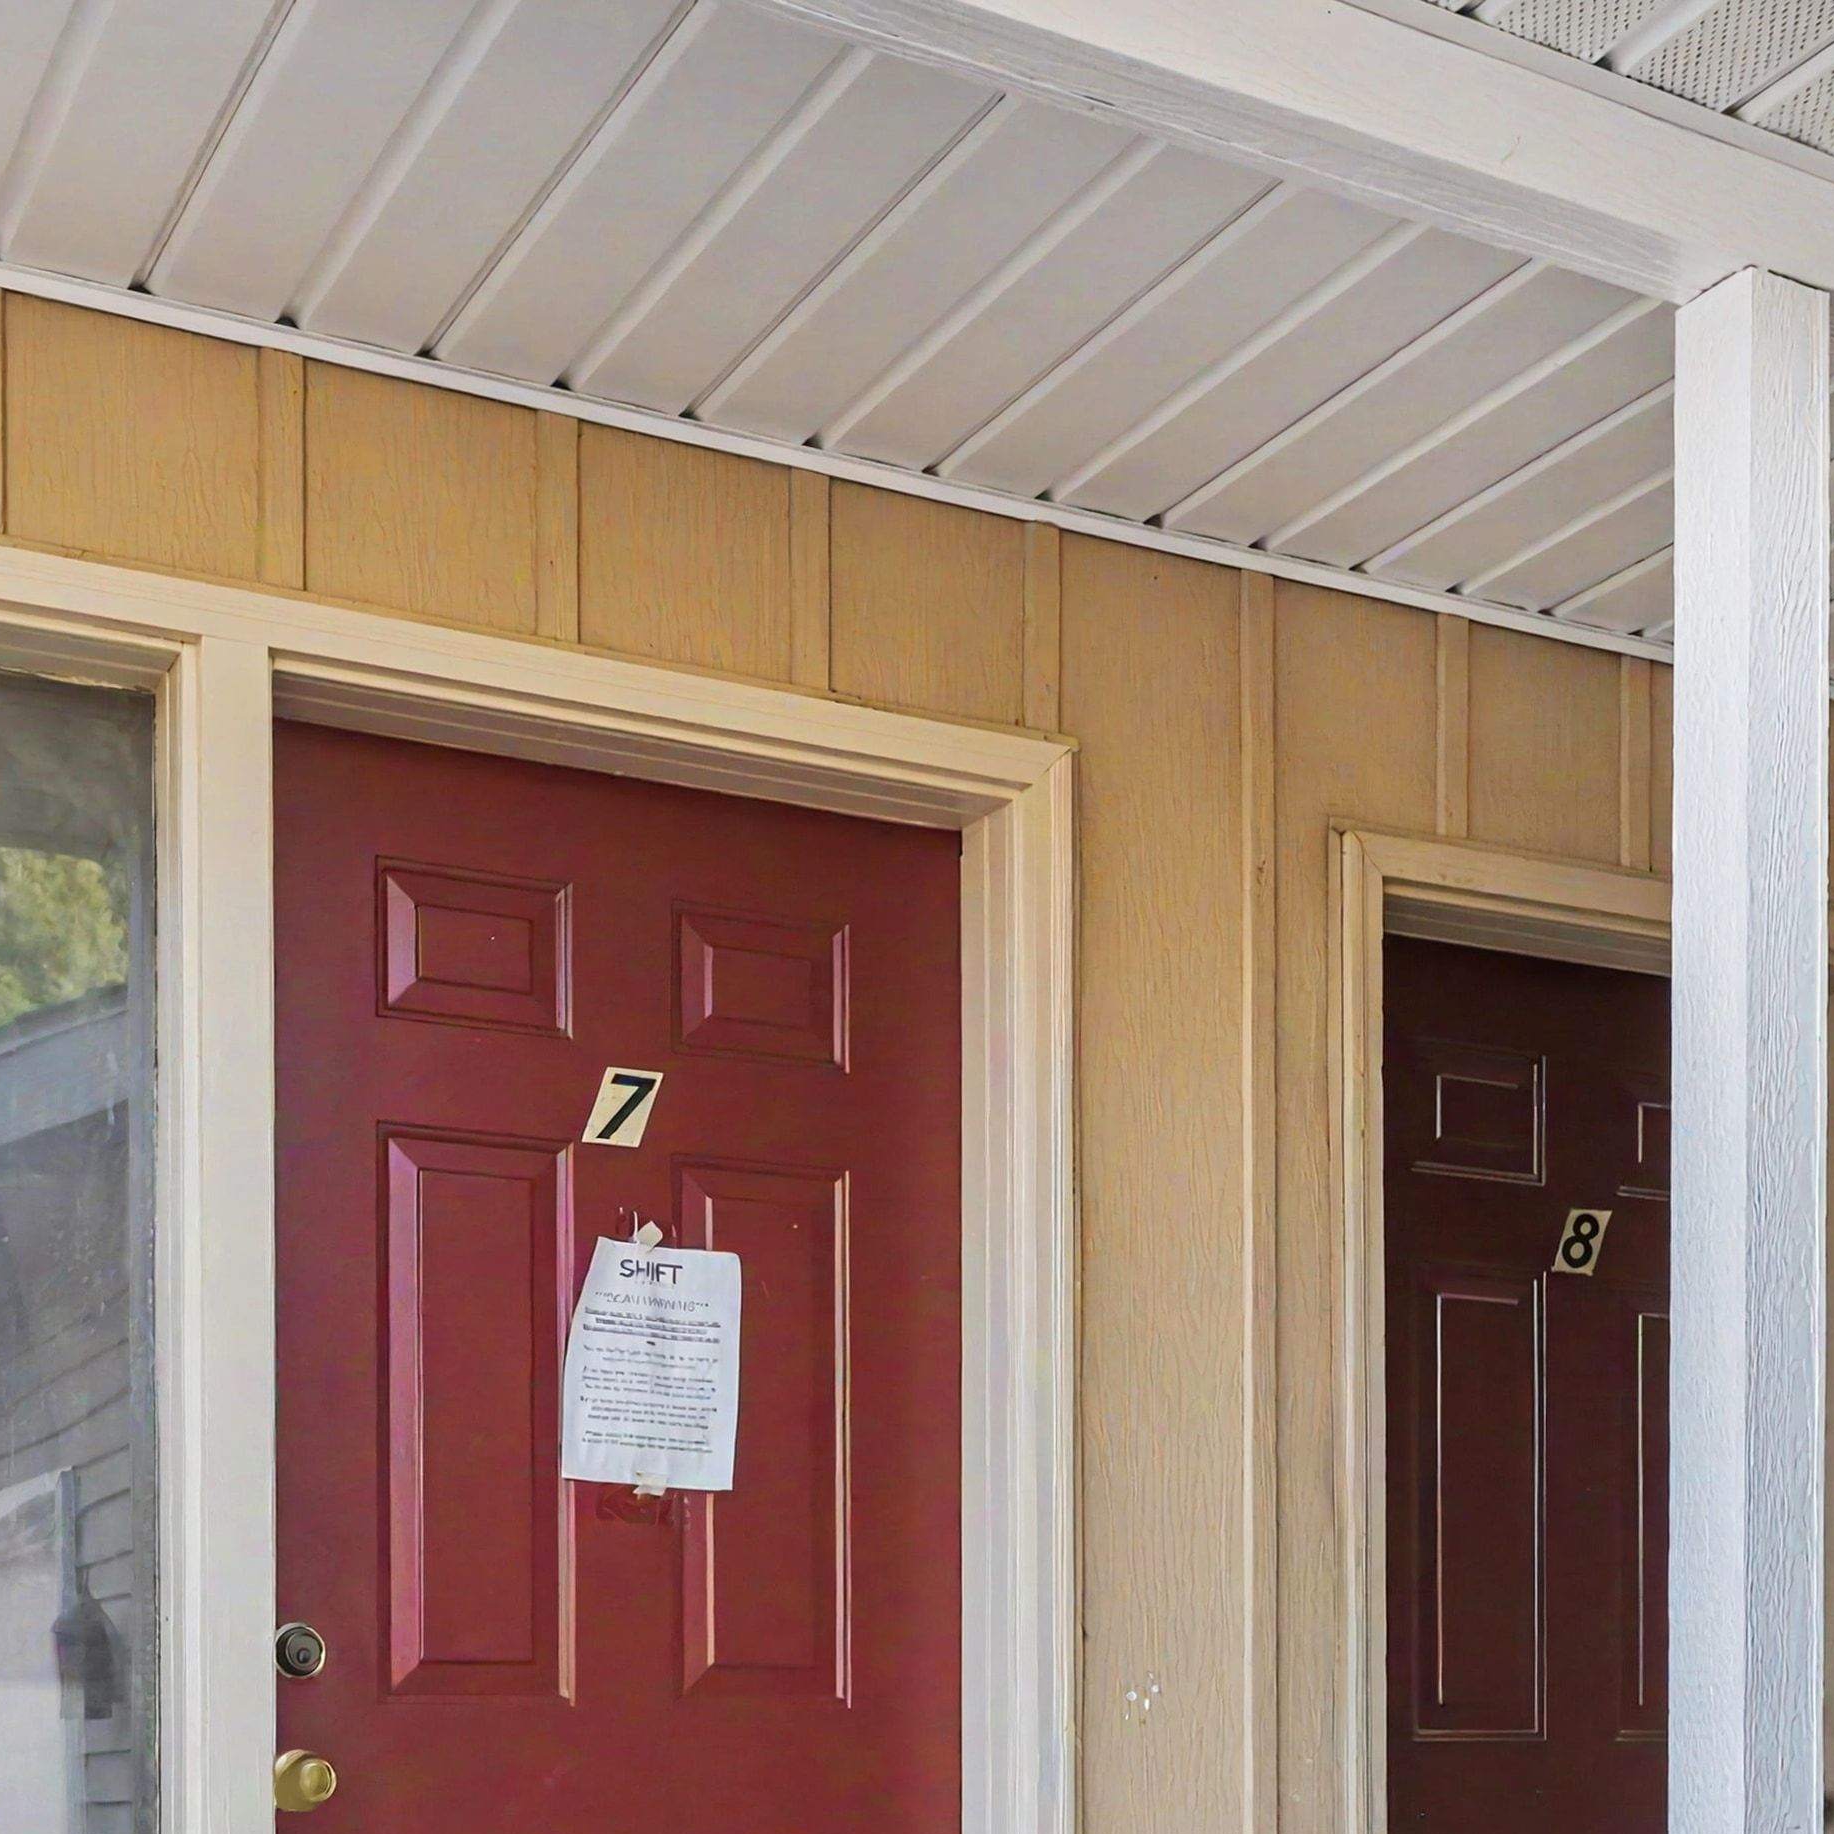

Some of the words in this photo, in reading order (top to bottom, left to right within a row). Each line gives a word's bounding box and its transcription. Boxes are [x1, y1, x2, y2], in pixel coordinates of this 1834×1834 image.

[596, 1073, 657, 1139] 7
[1562, 1213, 1599, 1268] 8
[619, 1259, 683, 1284] SHIFT
